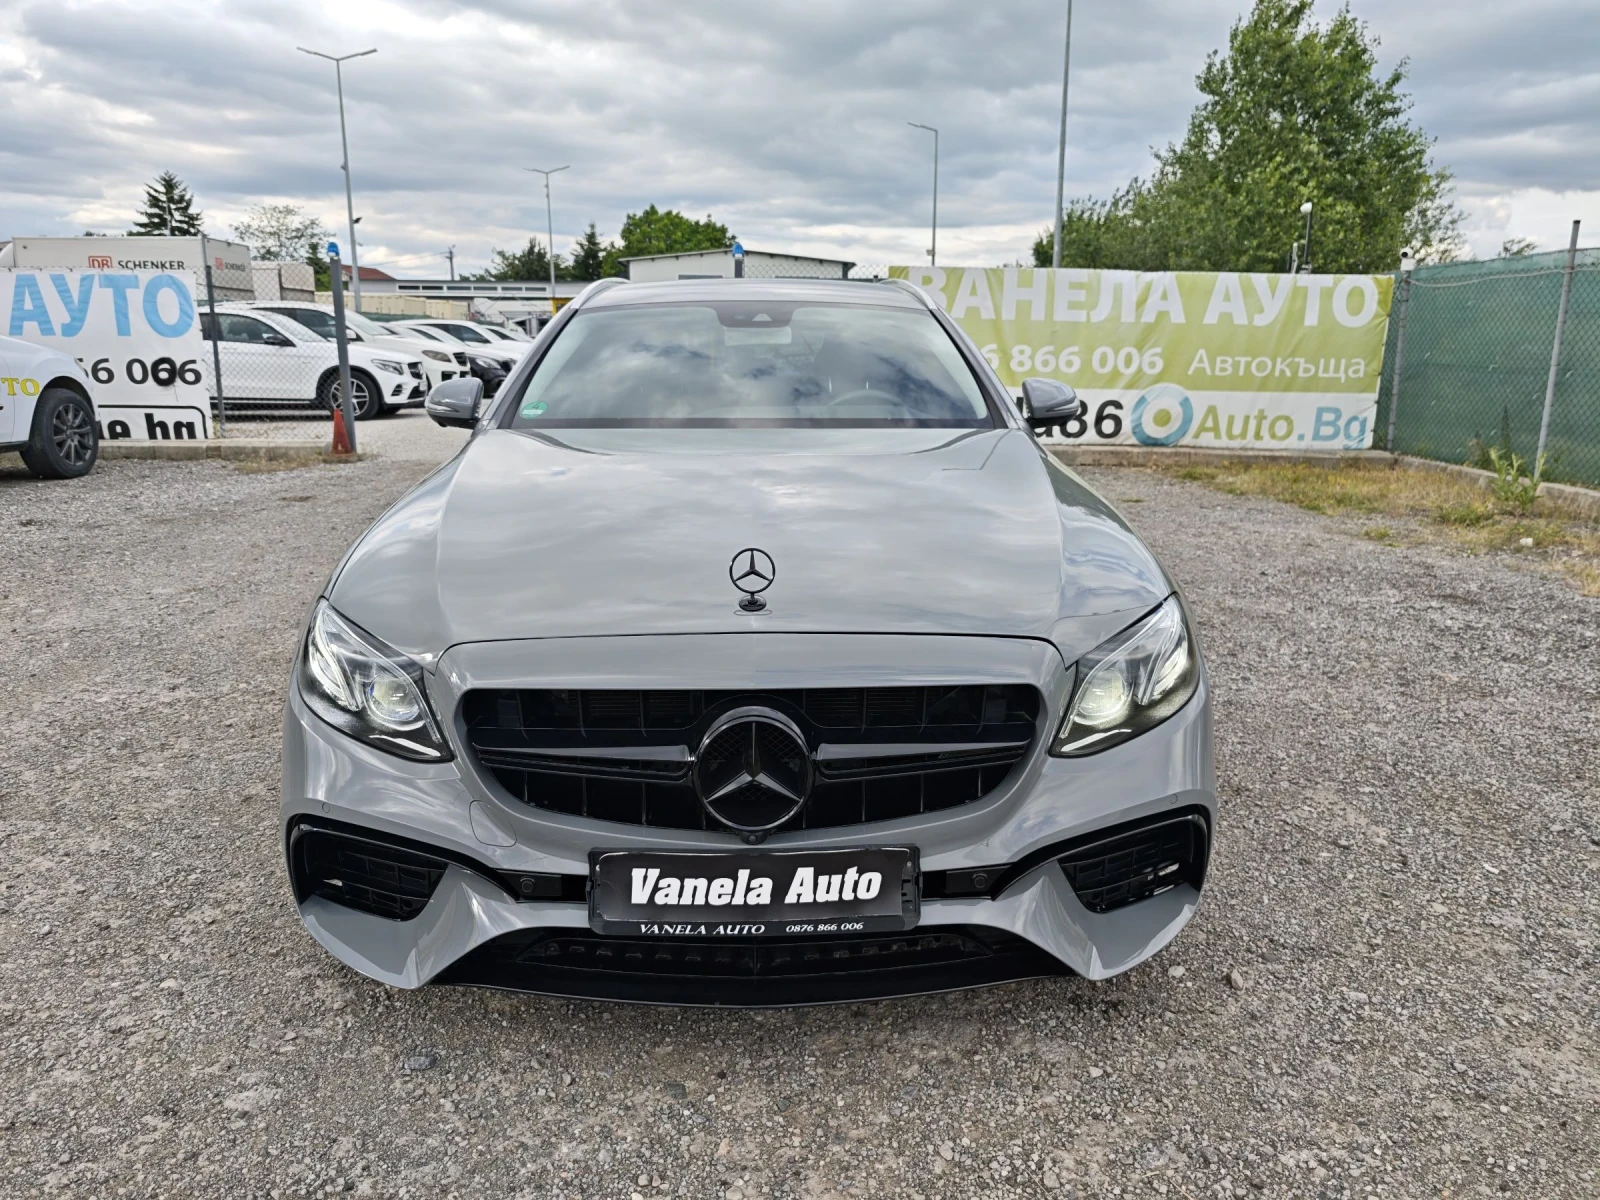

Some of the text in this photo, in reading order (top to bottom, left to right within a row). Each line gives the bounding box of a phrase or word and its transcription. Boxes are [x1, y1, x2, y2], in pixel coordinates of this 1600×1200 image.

[118, 260, 186, 271] SCHENKER
[9, 274, 195, 339] АУТО
[909, 266, 1378, 328] ВАНЕЛА АУТО
[1009, 345, 1082, 373] 866
[1092, 346, 1164, 375] 006
[1188, 349, 1366, 382] Автокъща
[1191, 404, 1367, 450] Auto.Bg
[631, 867, 882, 906] Vanela Auto
[640, 922, 864, 935] VANELA AUTO 0876 866 006
